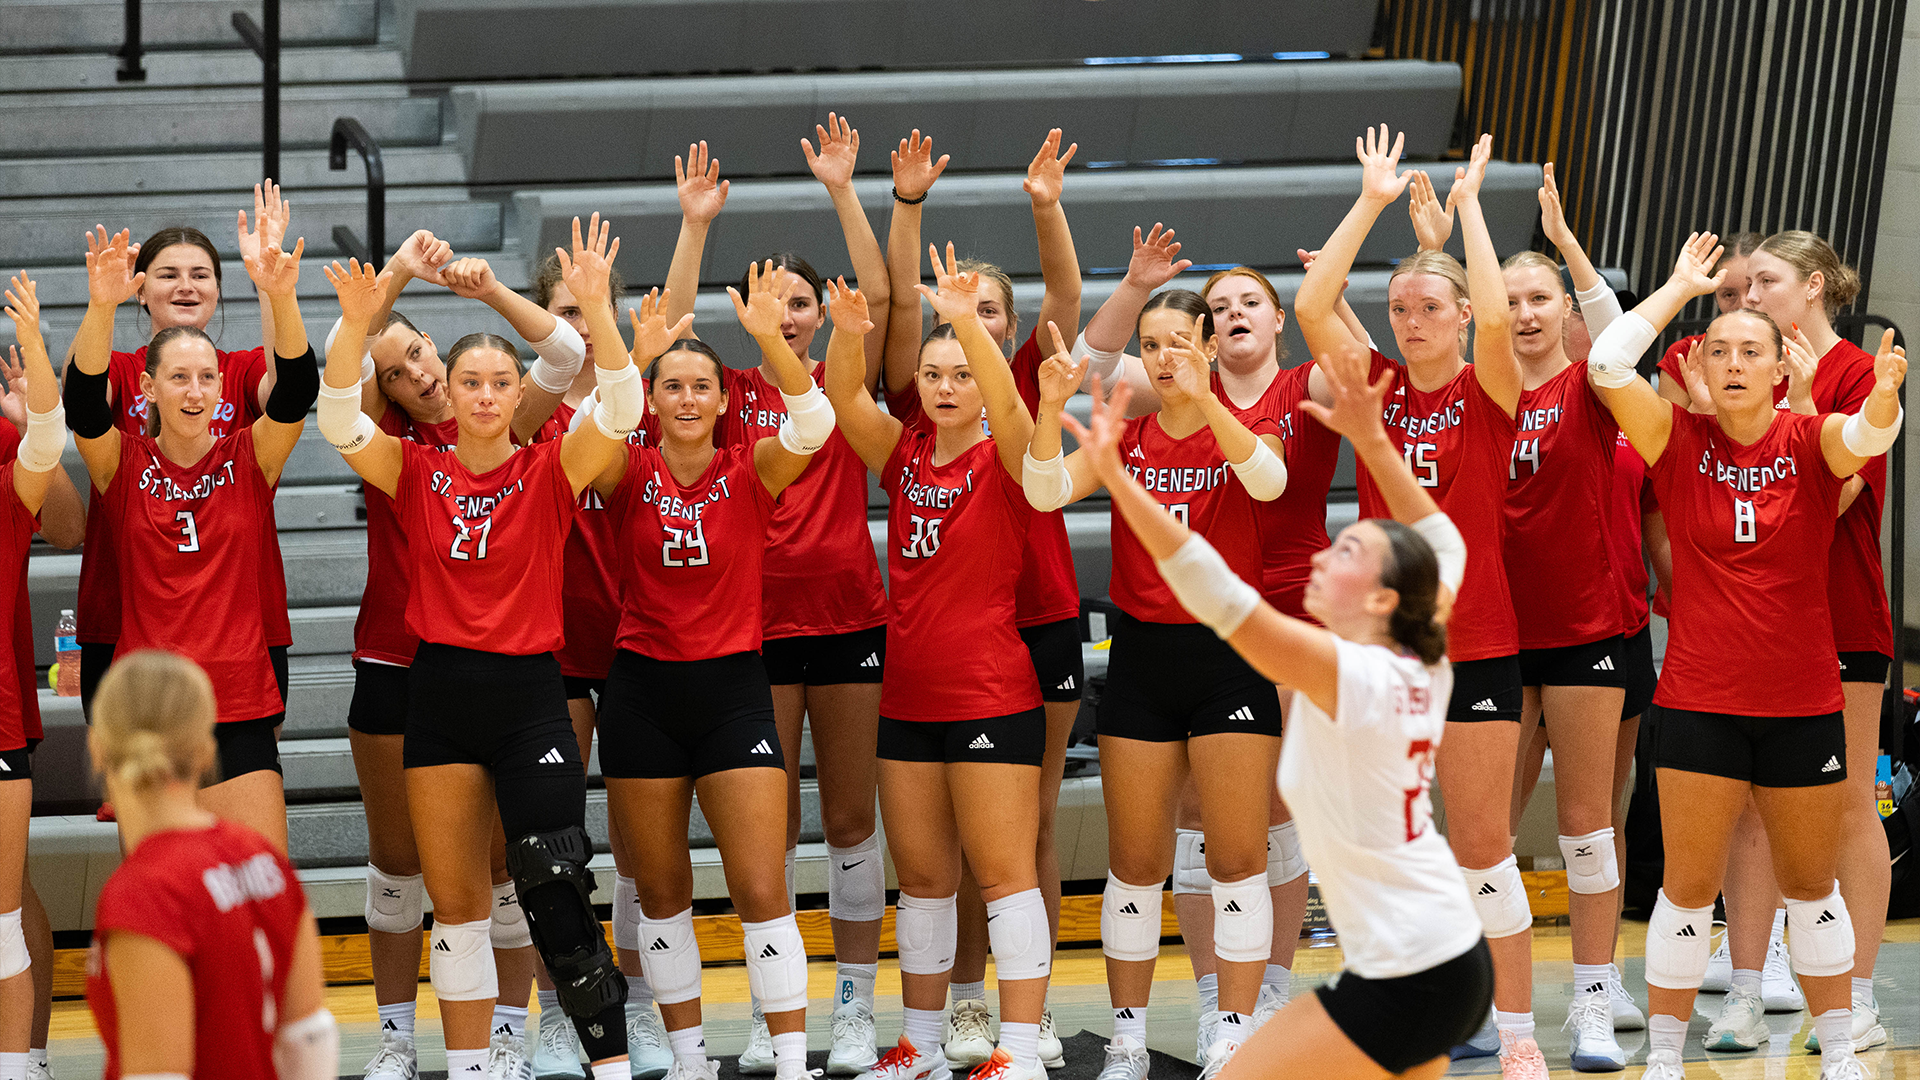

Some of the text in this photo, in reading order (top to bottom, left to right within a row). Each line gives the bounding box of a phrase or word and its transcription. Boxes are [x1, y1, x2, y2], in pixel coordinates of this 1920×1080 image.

[175, 511, 200, 552] 3
[450, 515, 493, 561] 27
[662, 519, 710, 567] 29
[901, 514, 943, 559] 30
[1734, 497, 1757, 543] 8
